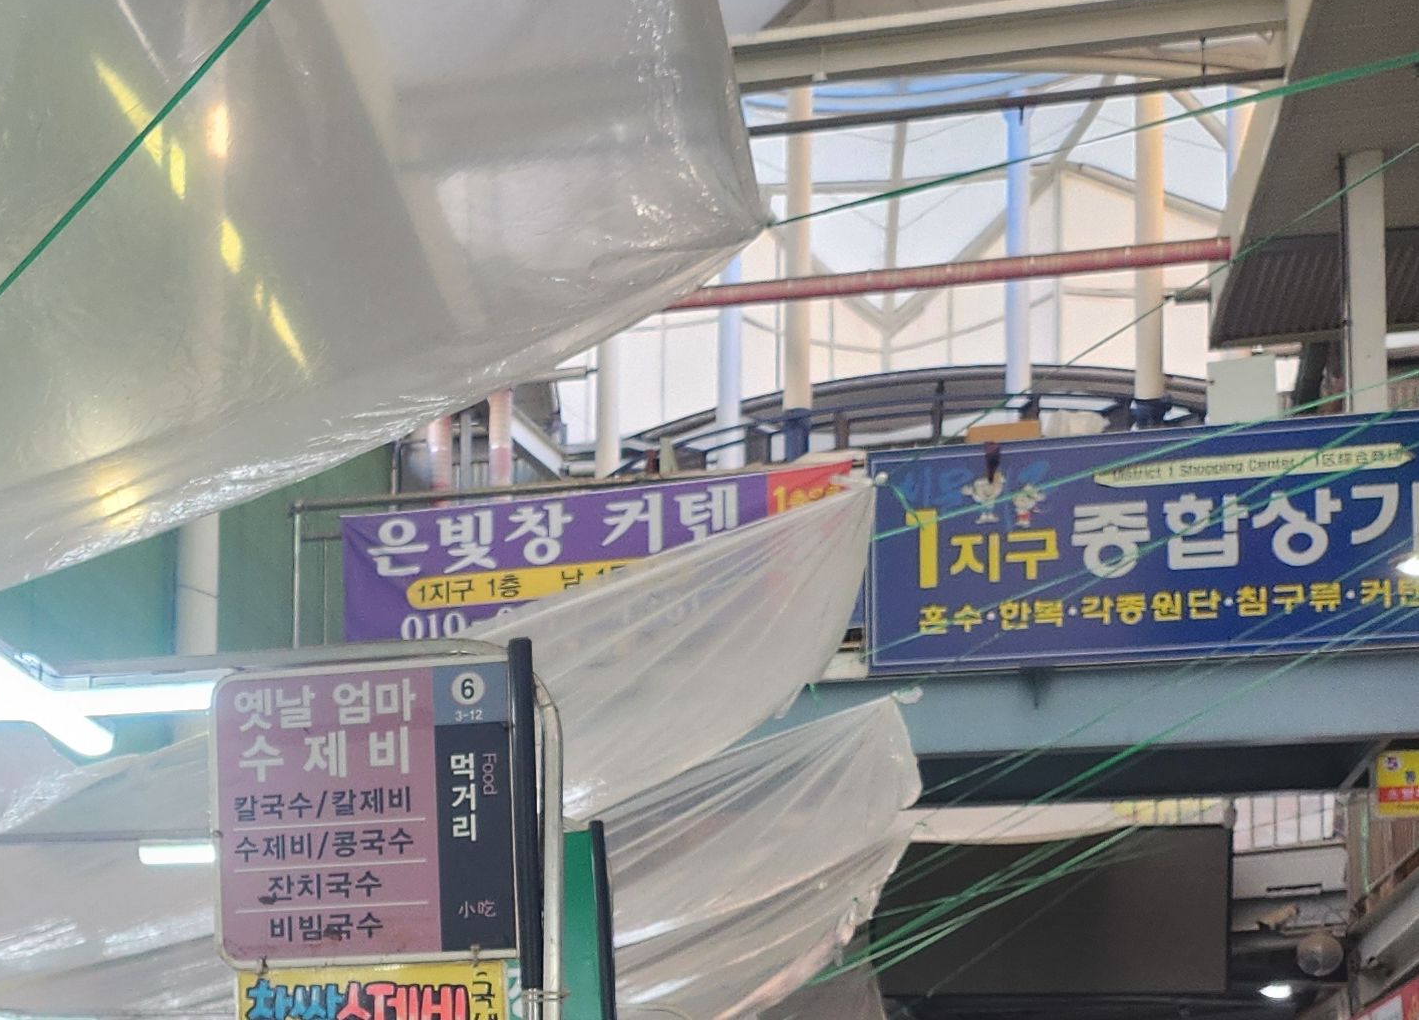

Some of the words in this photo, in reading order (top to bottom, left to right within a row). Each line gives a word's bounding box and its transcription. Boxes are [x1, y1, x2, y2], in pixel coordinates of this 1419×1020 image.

[366, 504, 574, 577] 은빛창
[905, 508, 1060, 589] 1지구
[418, 579, 474, 603] 1지구
[488, 574, 522, 598] 1층
[233, 684, 317, 732] 옛날
[332, 677, 416, 726] 엄마
[460, 677, 476, 699] 6
[454, 709, 484, 722] 3-12
[238, 726, 411, 783] 수제비
[482, 753, 498, 796] Food
[233, 786, 412, 823] 칼국수/칼제비
[449, 751, 479, 843] 먹거리
[234, 826, 415, 862] 수제비/콩국수
[267, 870, 383, 901] 잔치국수
[269, 912, 384, 943] 비빔국수
[457, 899, 497, 920] 小吃
